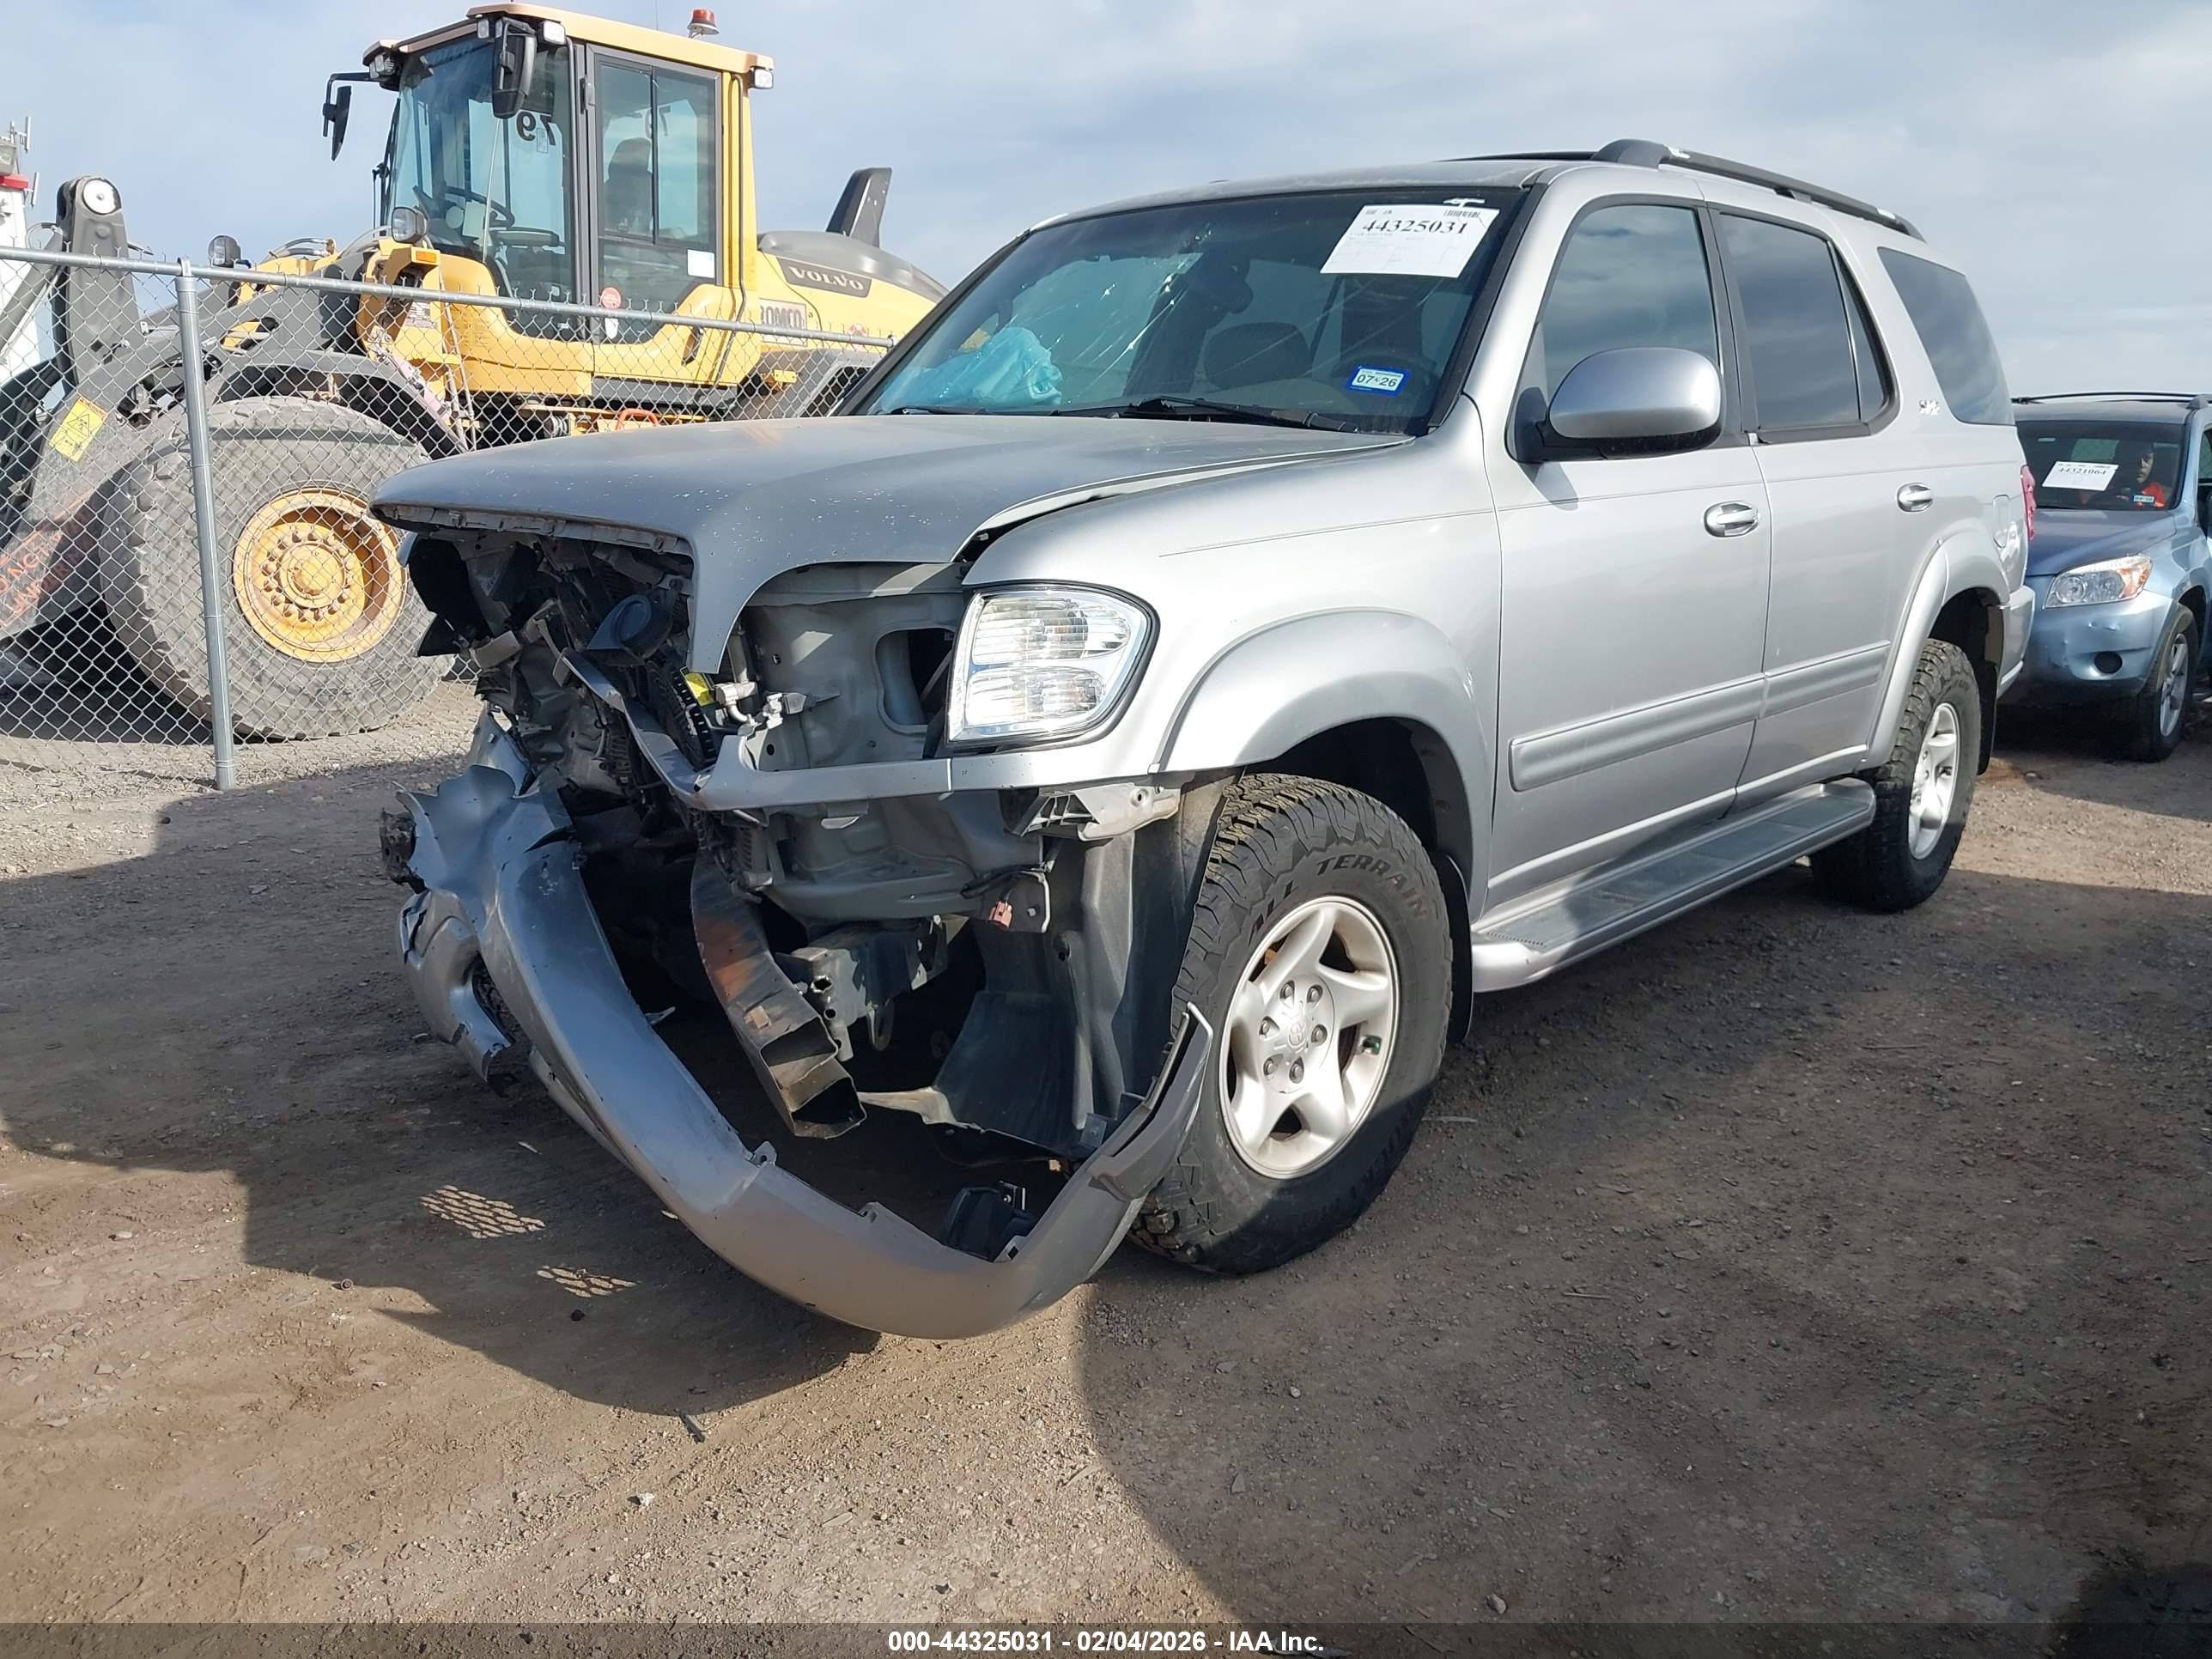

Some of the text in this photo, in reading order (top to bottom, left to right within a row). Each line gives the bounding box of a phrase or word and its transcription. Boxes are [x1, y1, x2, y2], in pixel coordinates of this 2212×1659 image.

[1362, 220, 1468, 234] 44325031
[788, 266, 865, 290] VOLVO
[1357, 374, 1399, 387] 07 26
[1316, 854, 1429, 921] TERRAIN
